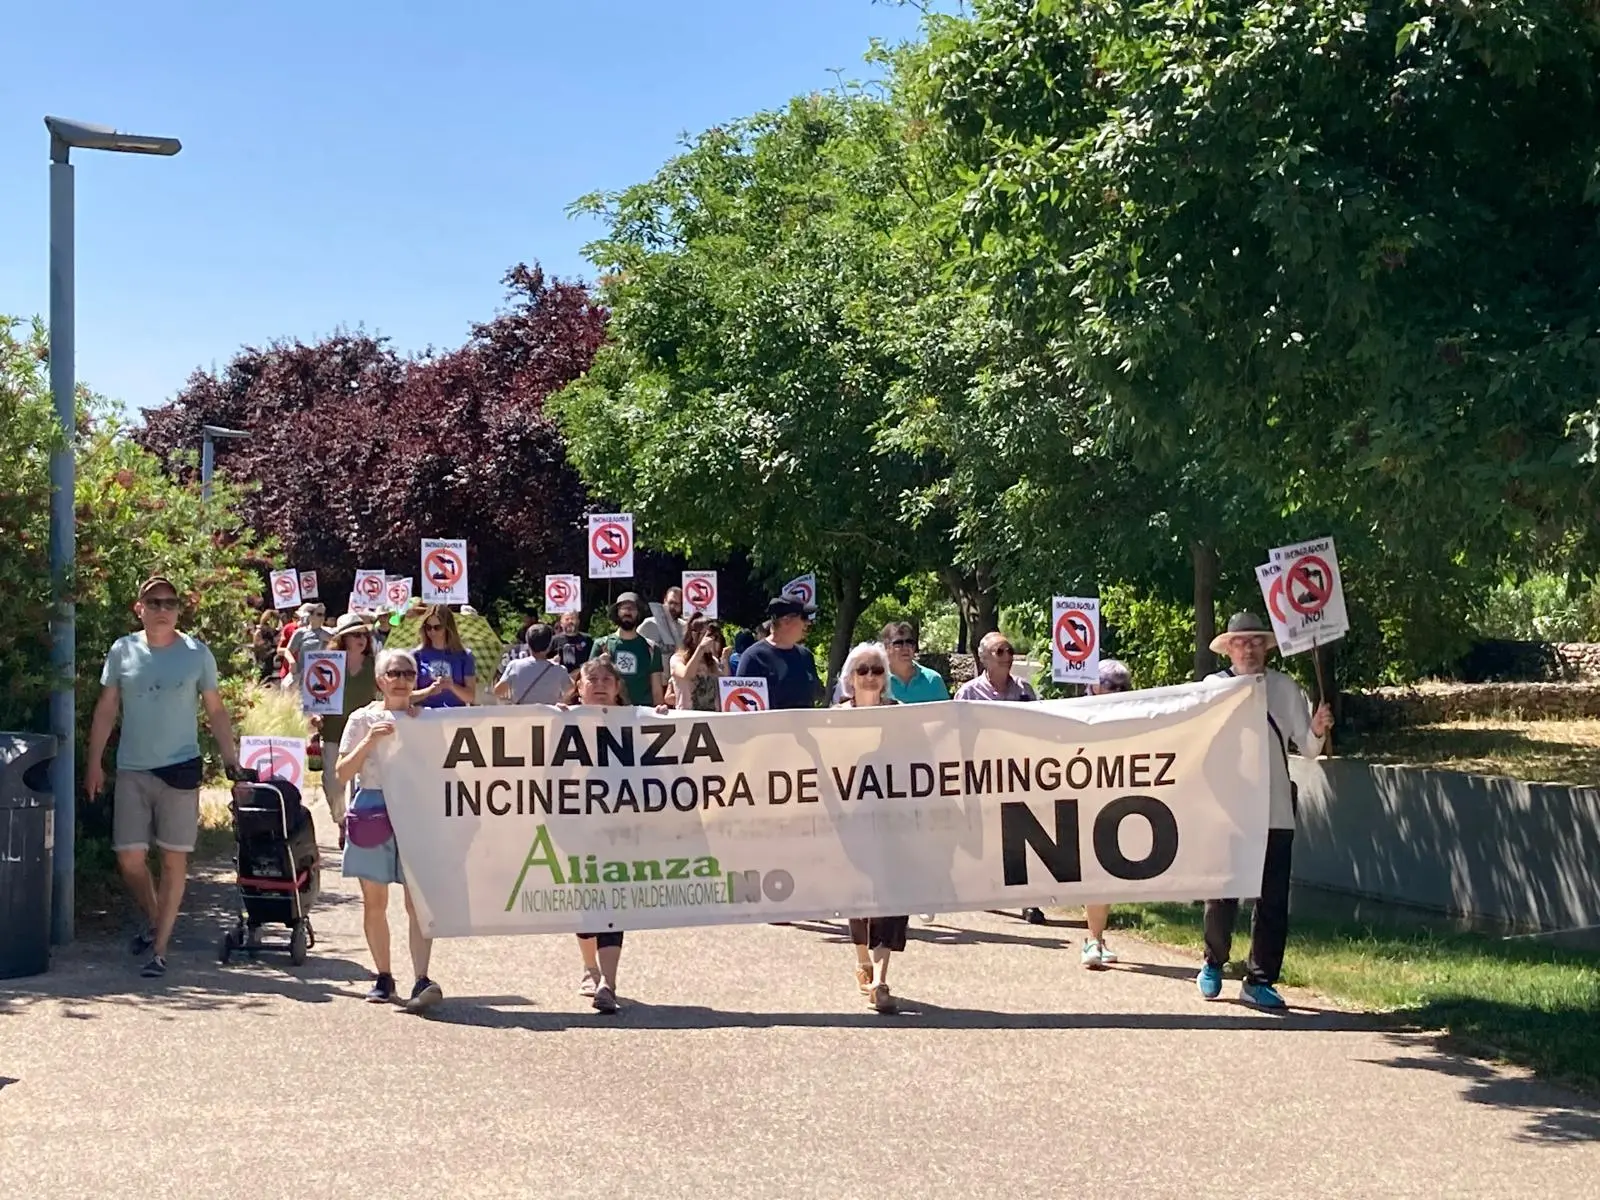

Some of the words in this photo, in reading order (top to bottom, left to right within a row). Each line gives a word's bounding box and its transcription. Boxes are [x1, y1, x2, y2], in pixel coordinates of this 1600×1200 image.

[1301, 609, 1324, 627] ¡NO!
[443, 722, 724, 768] ALIANZA
[445, 771, 754, 817] INCINERADORA
[767, 767, 819, 805] DE
[832, 747, 1177, 802] VALDEMINGÓMEZ
[504, 823, 721, 912] Alianza
[1001, 795, 1180, 887] NO
[521, 885, 607, 913] INCINERADORA
[611, 882, 628, 910] DE
[631, 878, 727, 909] VALDEMINGOMEZ
[727, 868, 795, 905] NO
